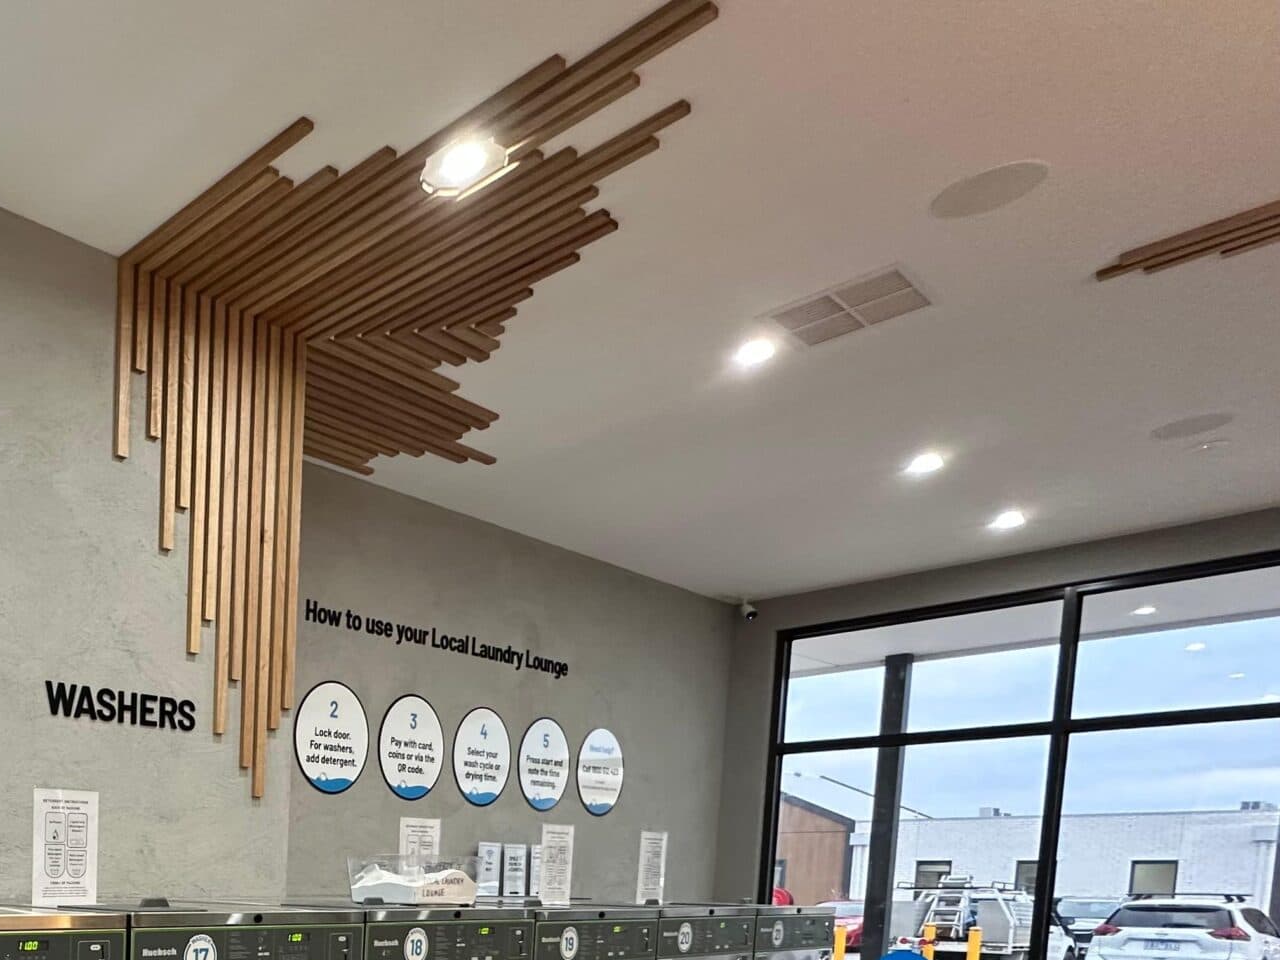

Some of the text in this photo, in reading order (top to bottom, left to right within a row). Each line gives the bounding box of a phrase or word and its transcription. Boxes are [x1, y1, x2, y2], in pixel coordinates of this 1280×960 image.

[304, 598, 569, 679] How to use your Local Laundry Lounge
[44, 679, 196, 732] WASHERS
[329, 700, 338, 718] 2
[409, 713, 417, 730] 3
[314, 726, 351, 740] Lock door.
[480, 723, 488, 740] 4
[309, 739, 322, 750] For
[390, 736, 402, 749] Pay
[403, 739, 417, 749] with
[543, 734, 550, 748] 5
[305, 754, 357, 769] add detergent.
[388, 751, 405, 761] coins
[414, 753, 424, 762] via
[424, 754, 435, 763] the
[565, 936, 574, 952] 19
[680, 931, 690, 945] 20
[410, 939, 423, 957] 18
